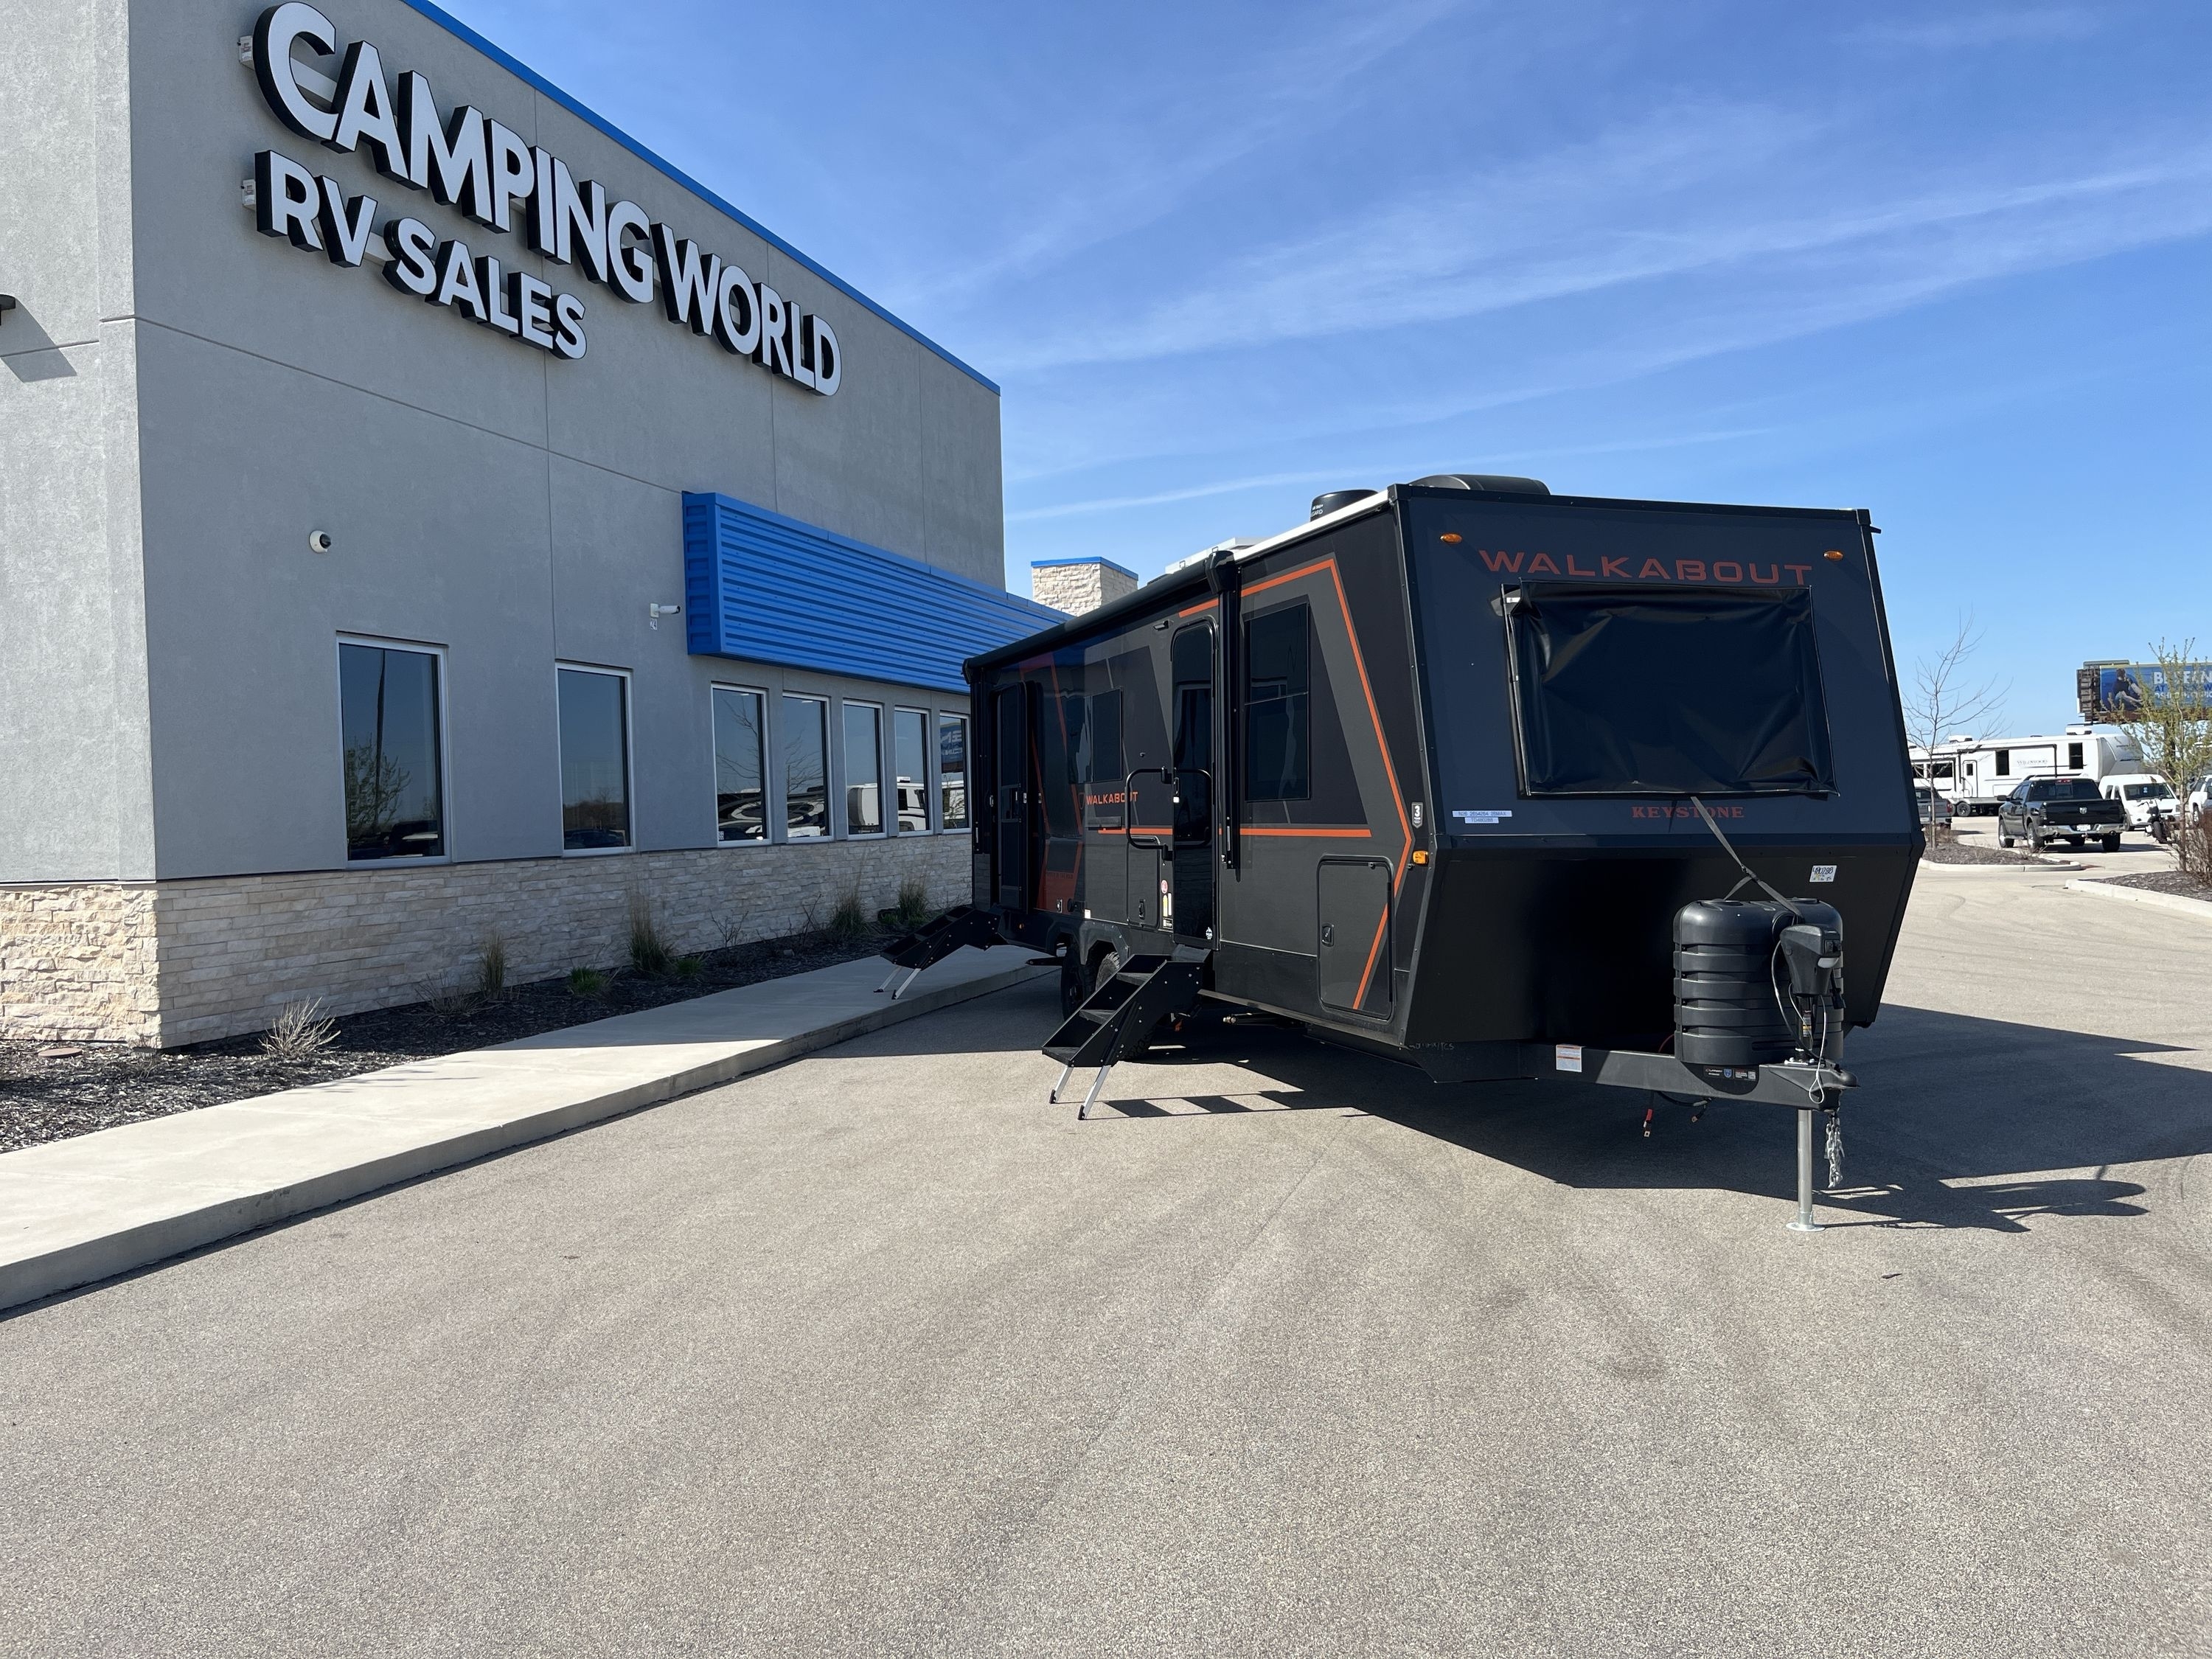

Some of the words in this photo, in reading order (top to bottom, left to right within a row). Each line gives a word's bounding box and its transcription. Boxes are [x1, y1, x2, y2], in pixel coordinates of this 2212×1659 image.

[255, 2, 654, 304] CAMPING
[653, 222, 842, 397] WORLD
[255, 150, 378, 268] RV
[383, 217, 588, 360] SALES
[1478, 549, 1813, 585] WALKABOUT
[1414, 804, 1421, 817] 3
[1630, 806, 1745, 818] KEYSTONE
